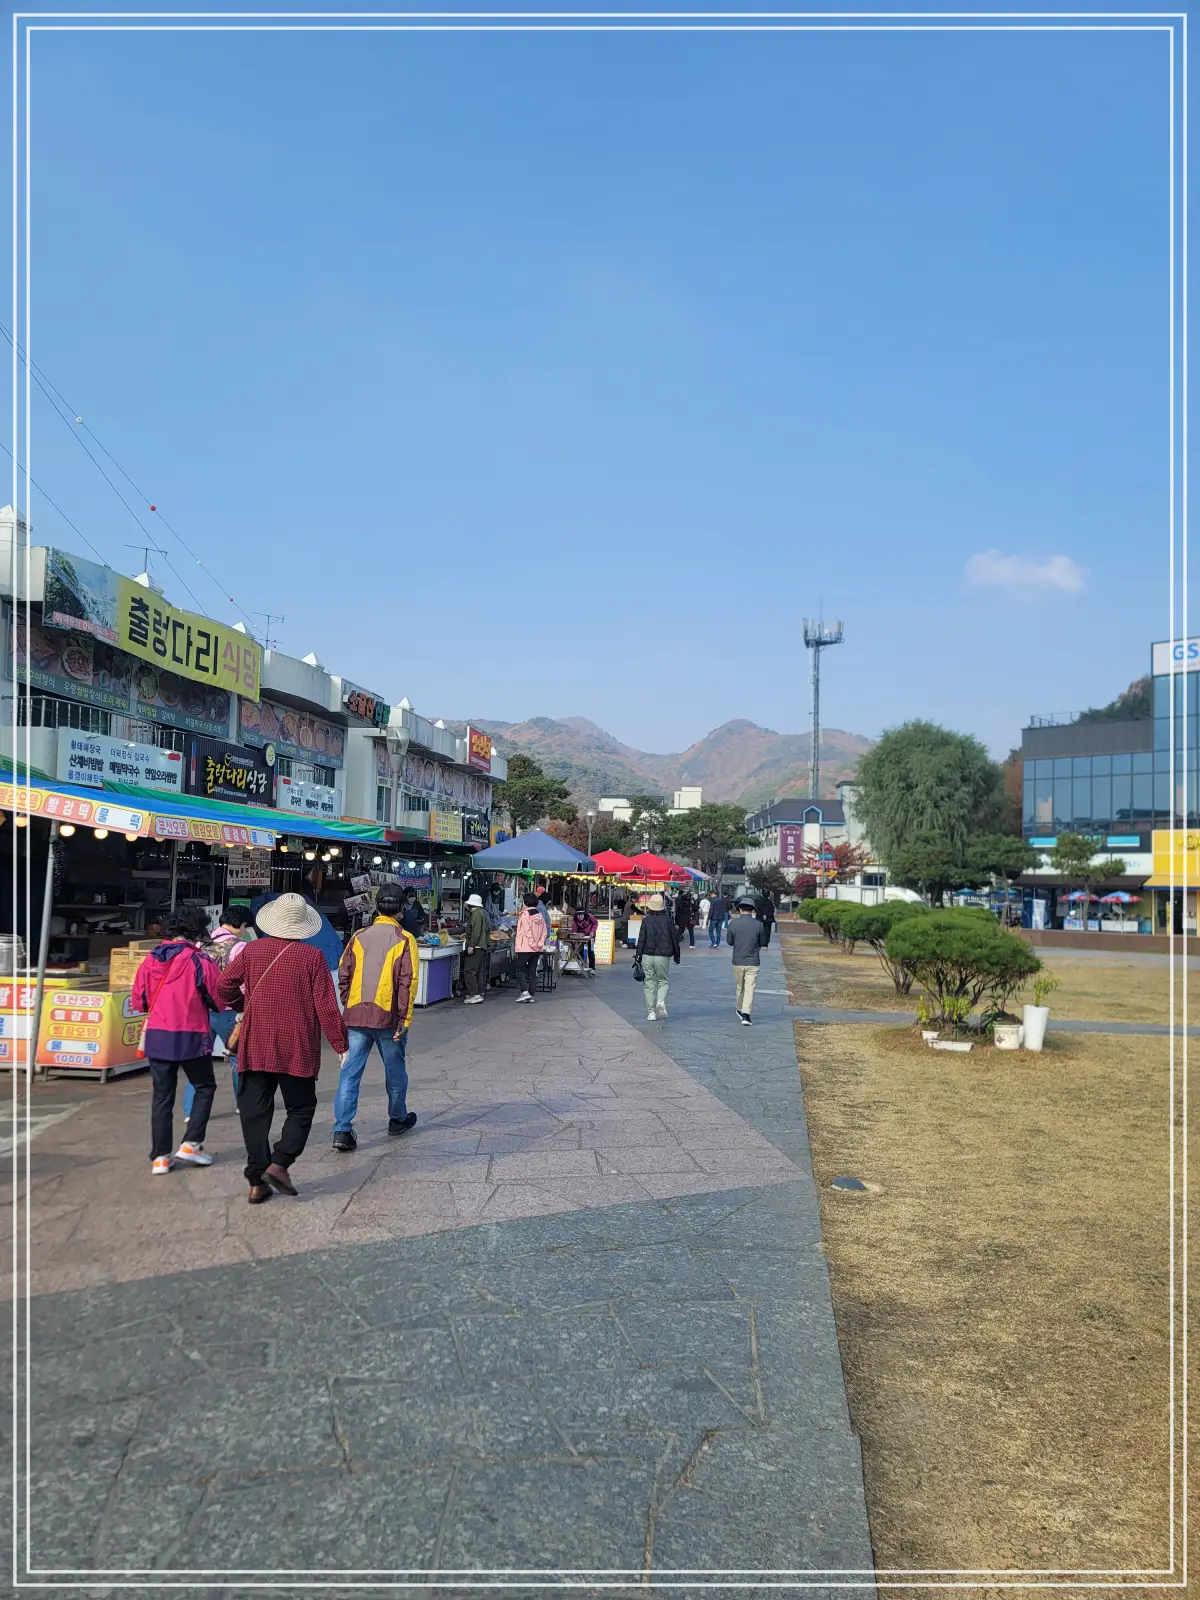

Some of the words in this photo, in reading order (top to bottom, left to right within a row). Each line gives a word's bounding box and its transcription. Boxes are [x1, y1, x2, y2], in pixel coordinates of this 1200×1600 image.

[129, 596, 218, 676] 출렁다리
[223, 640, 257, 690] 식당
[247, 770, 267, 794] 식당
[55, 1054, 92, 1065] 1000원
